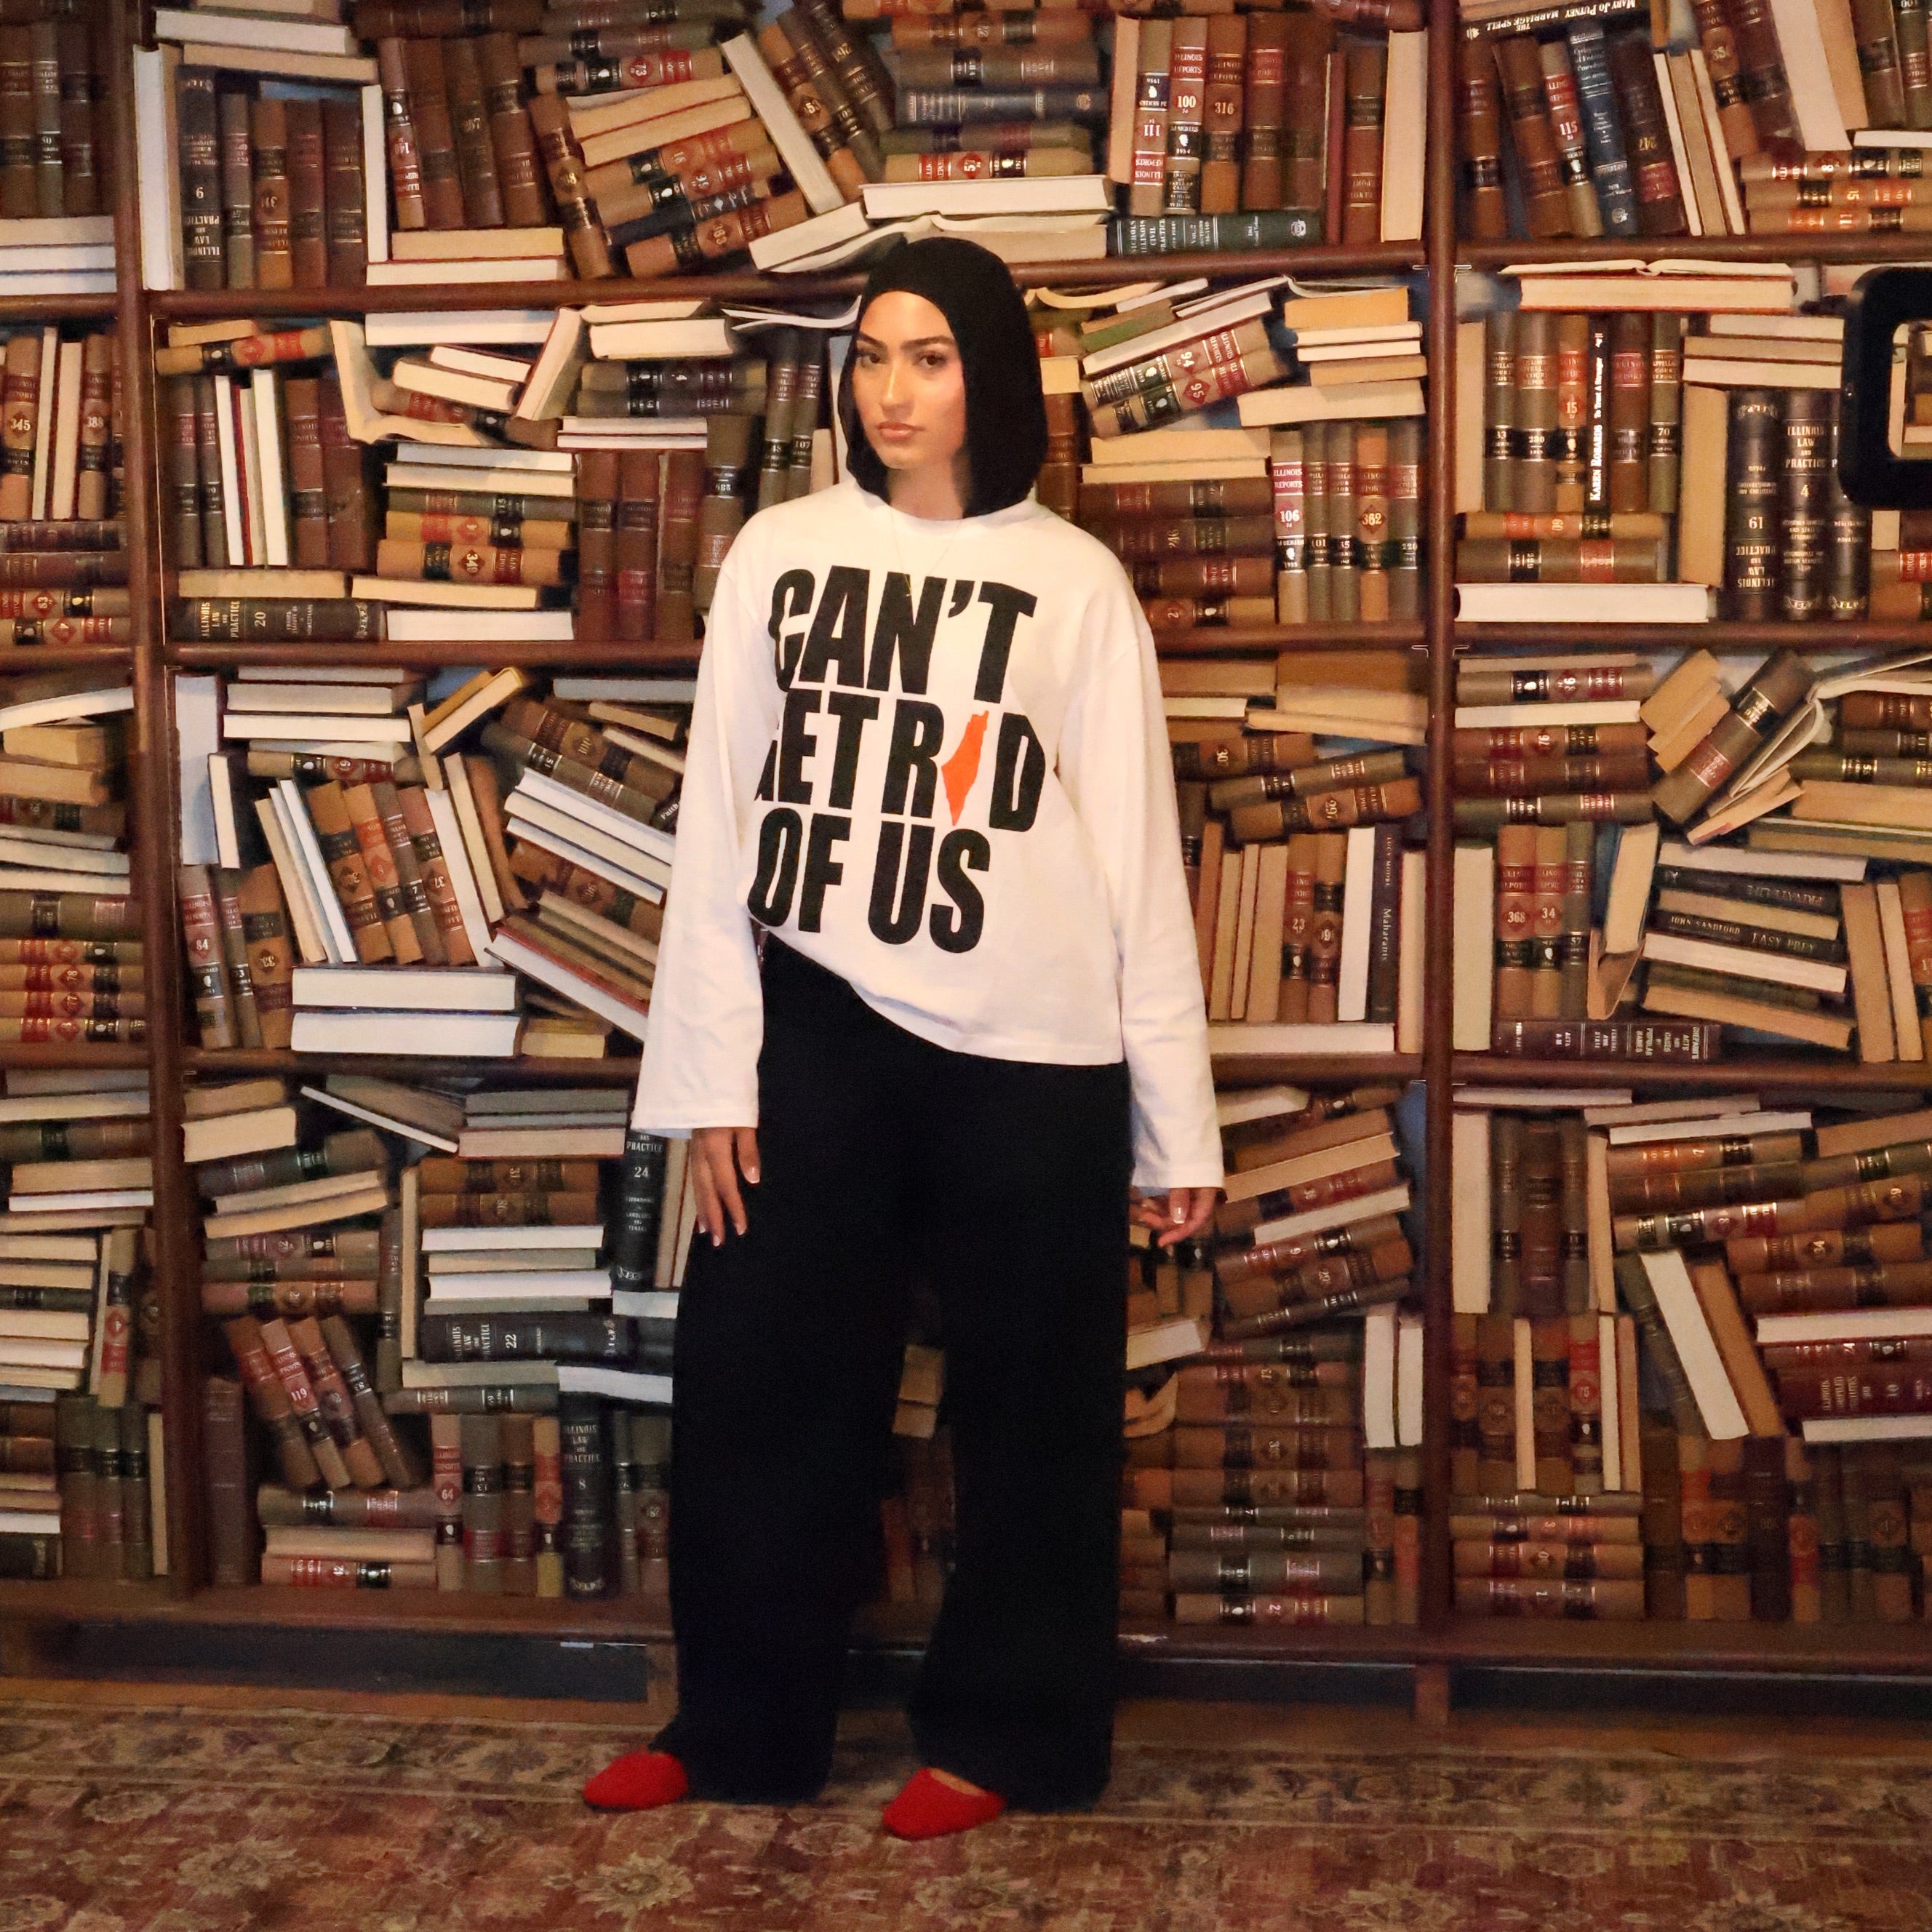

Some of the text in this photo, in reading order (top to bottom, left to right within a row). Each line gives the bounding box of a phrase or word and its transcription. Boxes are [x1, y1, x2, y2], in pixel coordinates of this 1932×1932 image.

[1565, 6, 1597, 19] PUTNEY
[1486, 10, 1559, 31] MARRIAGE SPELL
[1177, 96, 1197, 108] 100
[1560, 121, 1578, 136] 115
[1181, 351, 1194, 367] 94
[1190, 383, 1205, 399] 95
[1566, 402, 1578, 414] 15
[10, 418, 31, 431] 345
[1797, 439, 1815, 447] LAW
[1590, 424, 1602, 501] KAREN ROBARDS
[1274, 468, 1303, 476] ILLINOIS
[1274, 481, 1304, 489] REPORTS
[1800, 484, 1811, 497] 4
[1280, 510, 1300, 523] 106
[1361, 513, 1382, 526] 362
[1747, 567, 1765, 575] LAW
[212, 611, 220, 627] LAW
[255, 611, 266, 627] 20
[768, 565, 1037, 703] CAN'T
[747, 807, 991, 954] OF US
[1507, 911, 1525, 923] 368
[1541, 908, 1556, 919] 34
[1645, 1027, 1653, 1056] POPULAR
[634, 1166, 649, 1178] 24
[463, 1334, 471, 1351] LAW
[505, 1333, 517, 1349] 22
[291, 1388, 308, 1402] 119
[572, 1435, 588, 1445] LAW
